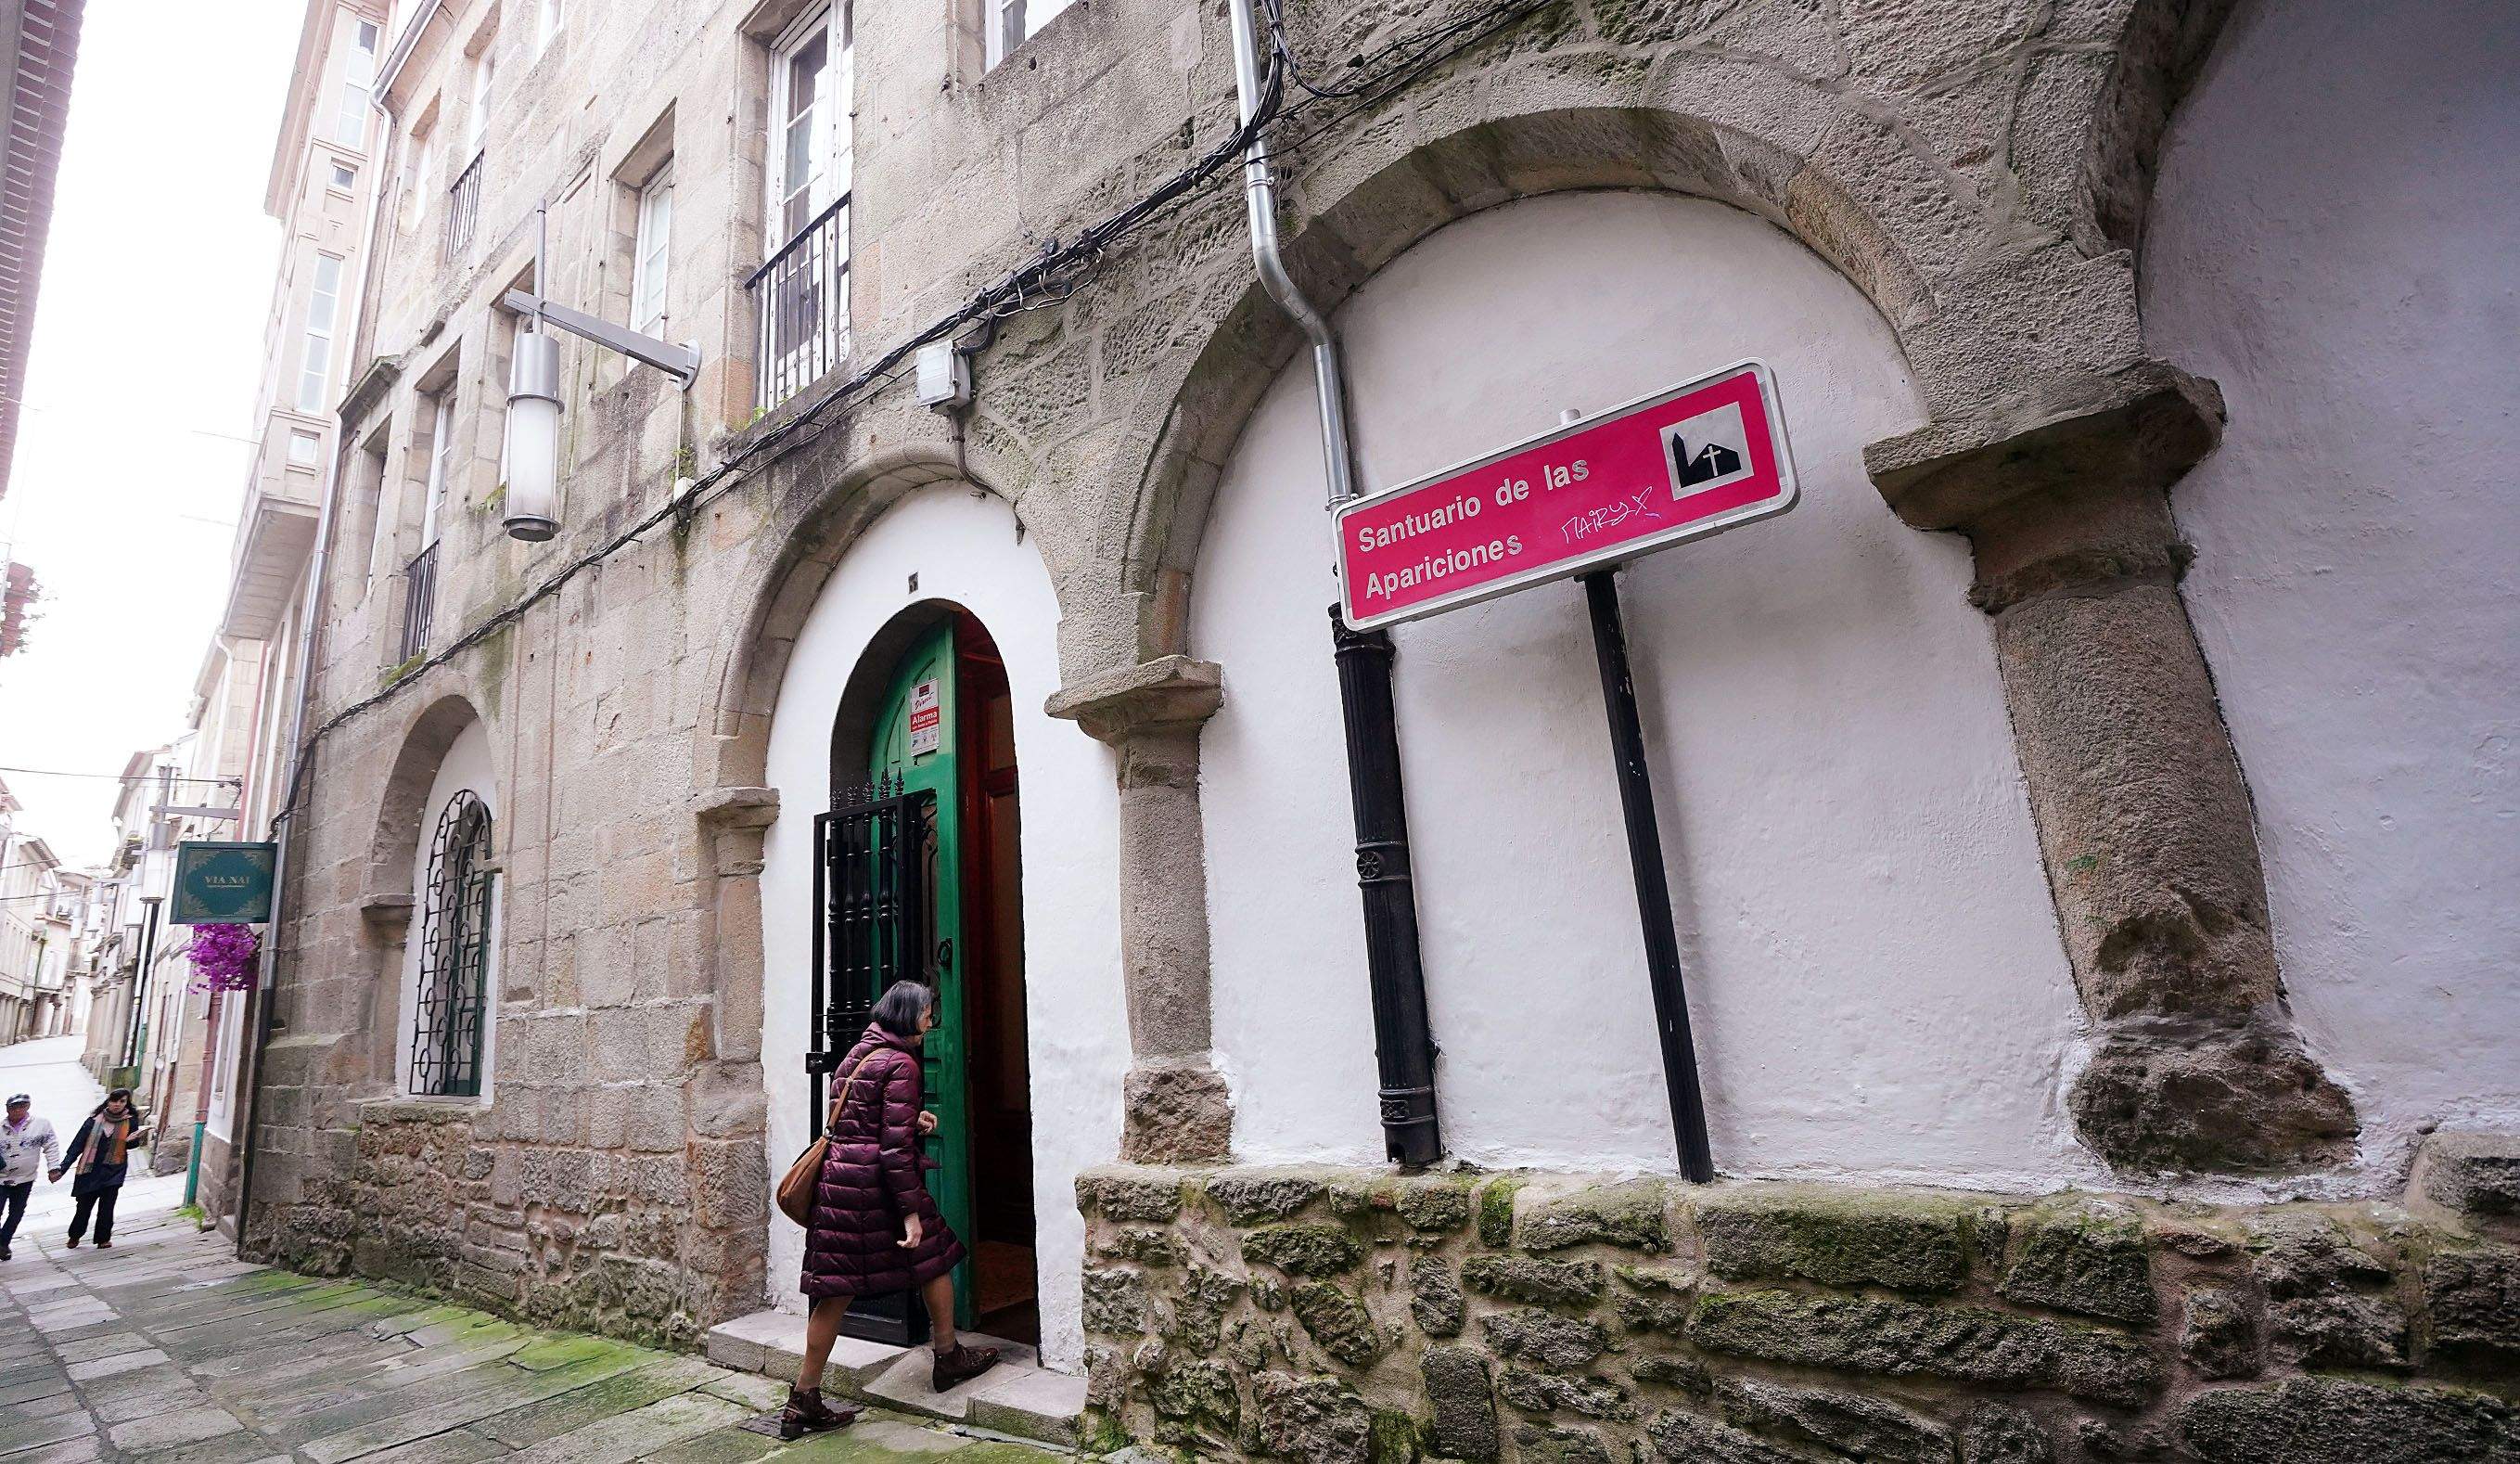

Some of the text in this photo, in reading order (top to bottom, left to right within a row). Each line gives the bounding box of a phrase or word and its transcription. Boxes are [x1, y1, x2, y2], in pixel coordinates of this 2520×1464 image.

[1358, 456, 1591, 553] Santuario de las
[1364, 533, 1525, 600] Apariciones
[912, 711, 938, 726] Alarma
[204, 876, 225, 884] VIA
